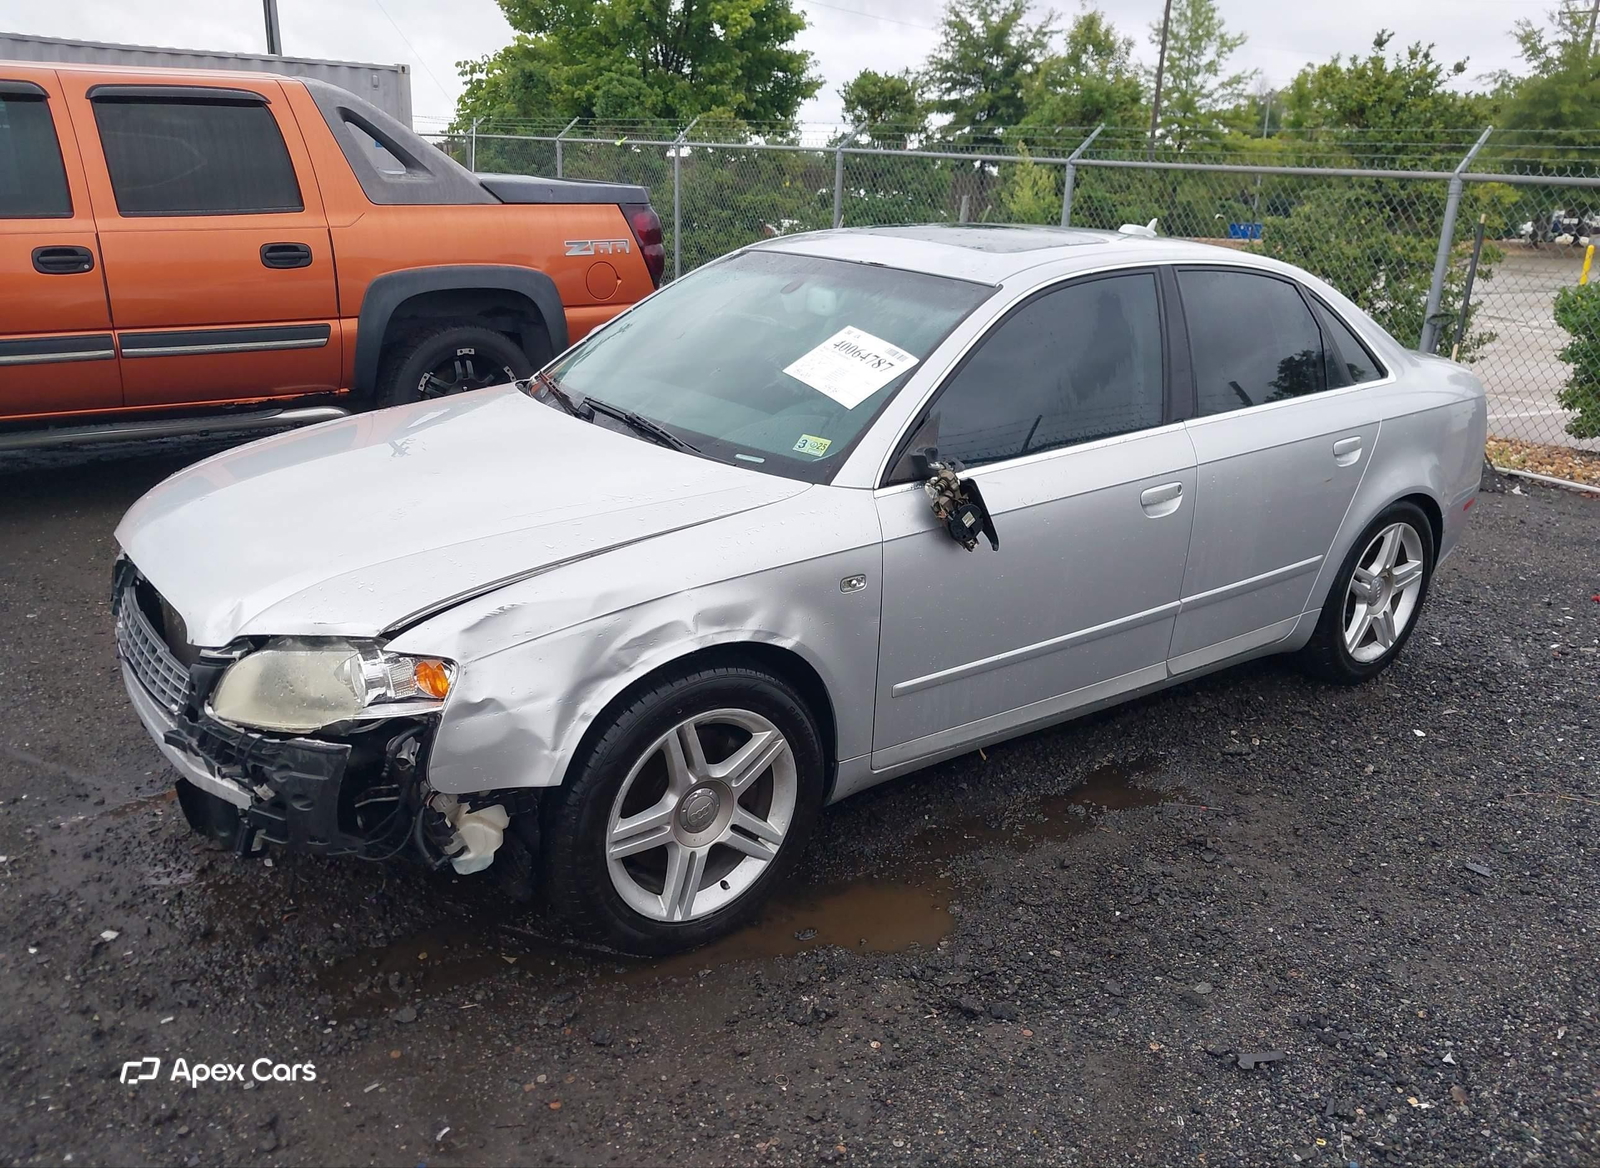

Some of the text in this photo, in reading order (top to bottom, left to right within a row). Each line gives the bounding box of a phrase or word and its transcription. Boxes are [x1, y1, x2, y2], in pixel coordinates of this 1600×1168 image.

[833, 339, 896, 373] 40064787
[798, 439, 828, 451] 3 25
